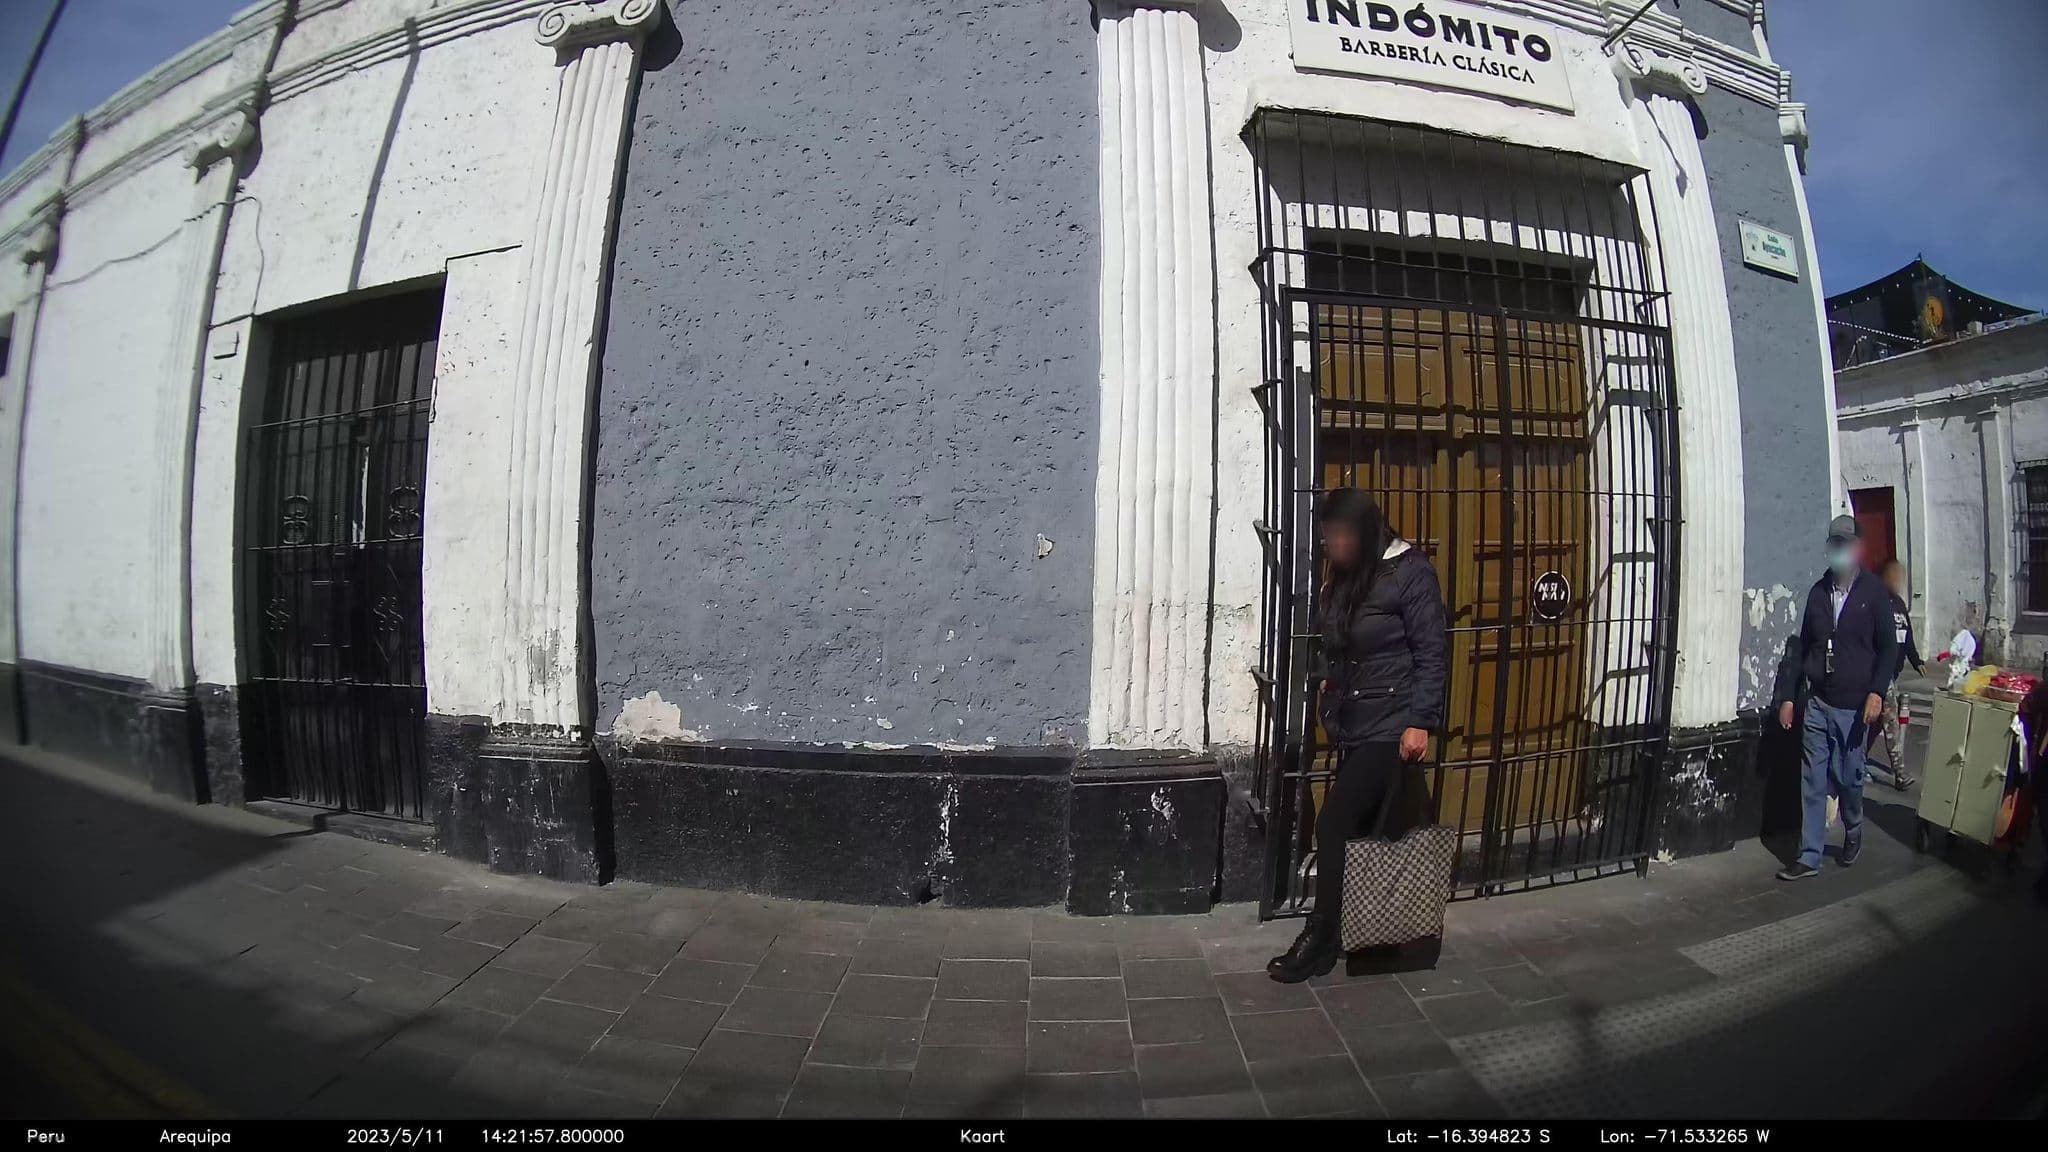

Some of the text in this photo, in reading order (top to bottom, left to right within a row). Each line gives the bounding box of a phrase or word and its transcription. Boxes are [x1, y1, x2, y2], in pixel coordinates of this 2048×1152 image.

[1306, 0, 1552, 62] INDÓMITO
[1339, 37, 1535, 84] BARBERÍA CLÁSICA
